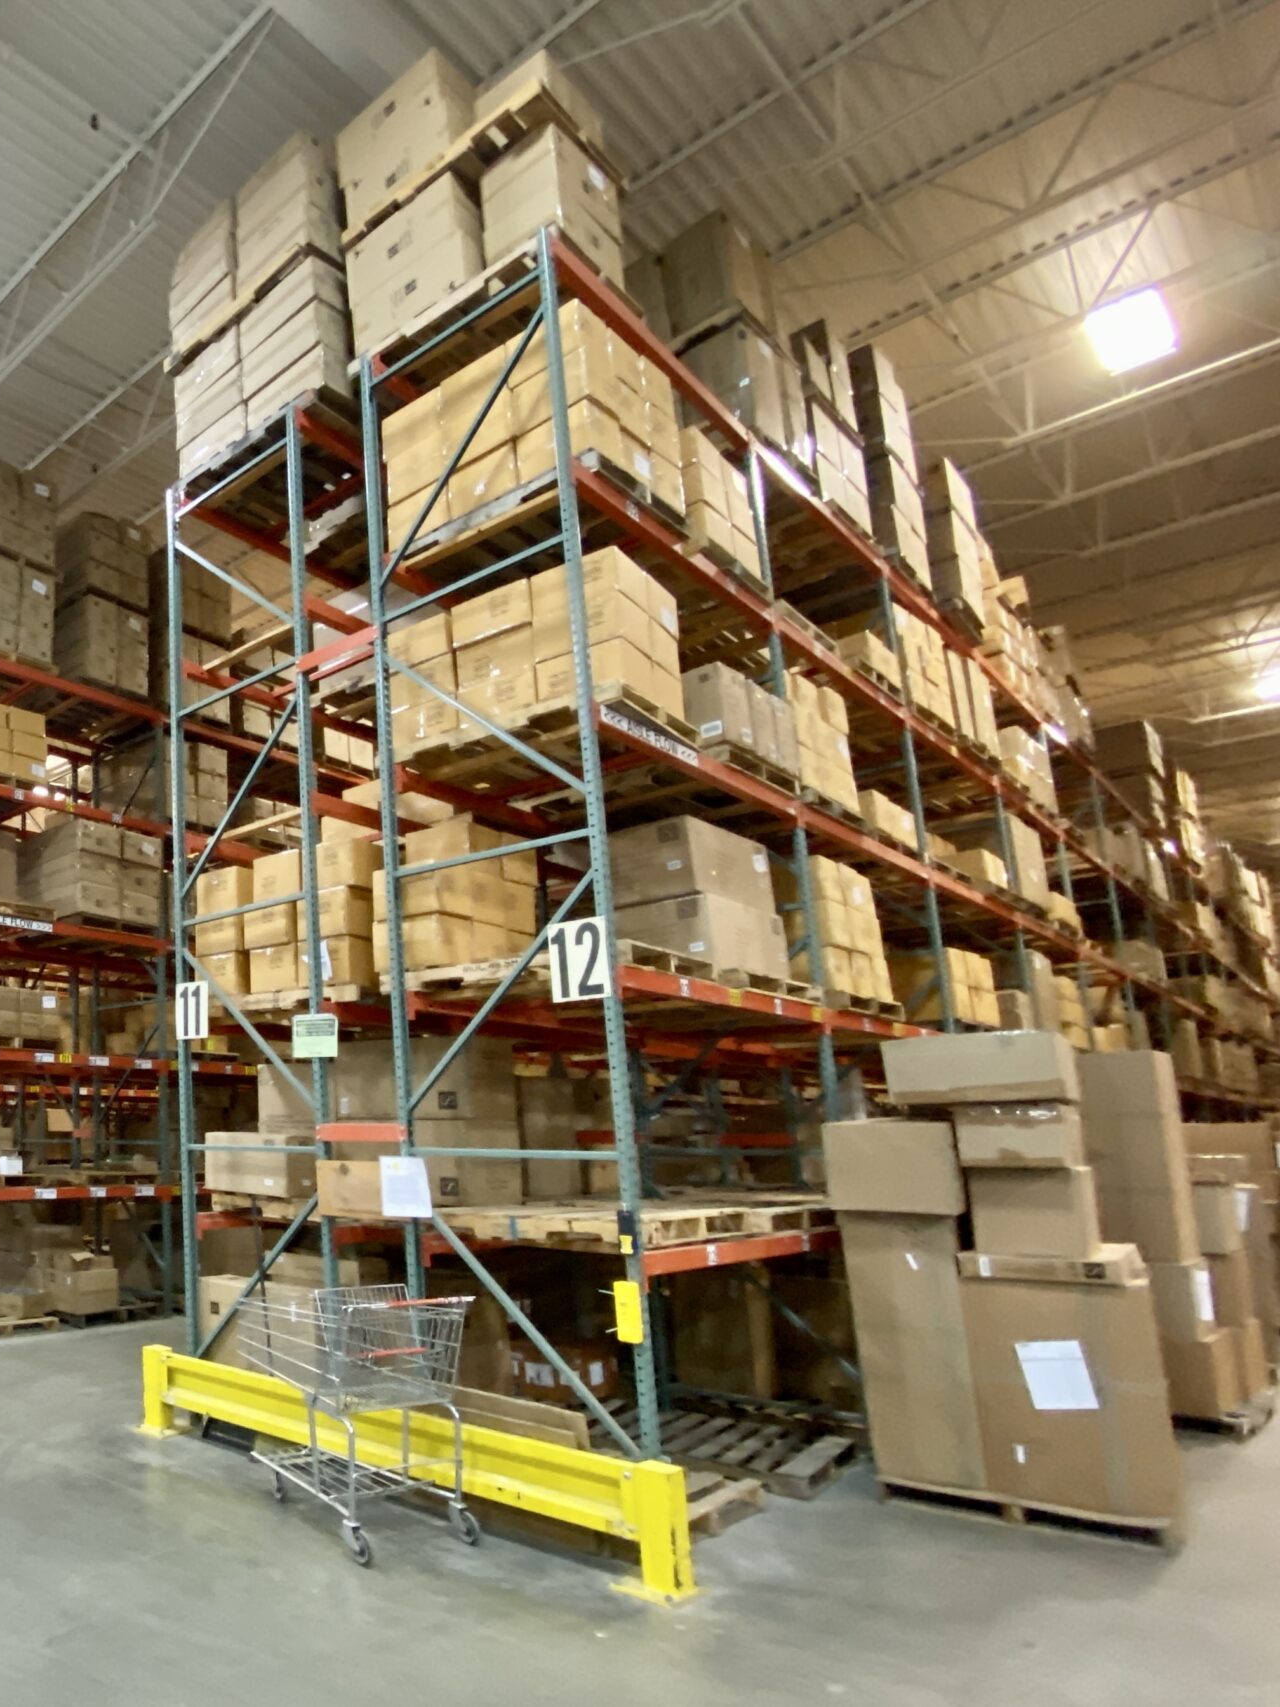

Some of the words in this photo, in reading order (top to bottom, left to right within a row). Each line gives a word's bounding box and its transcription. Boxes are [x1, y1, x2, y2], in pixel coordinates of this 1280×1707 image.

[627, 719, 652, 740] AISLE
[654, 731, 678, 755] FLOW
[10, 916, 34, 928] FLOW
[550, 921, 605, 998] 12
[179, 985, 201, 1037] 11
